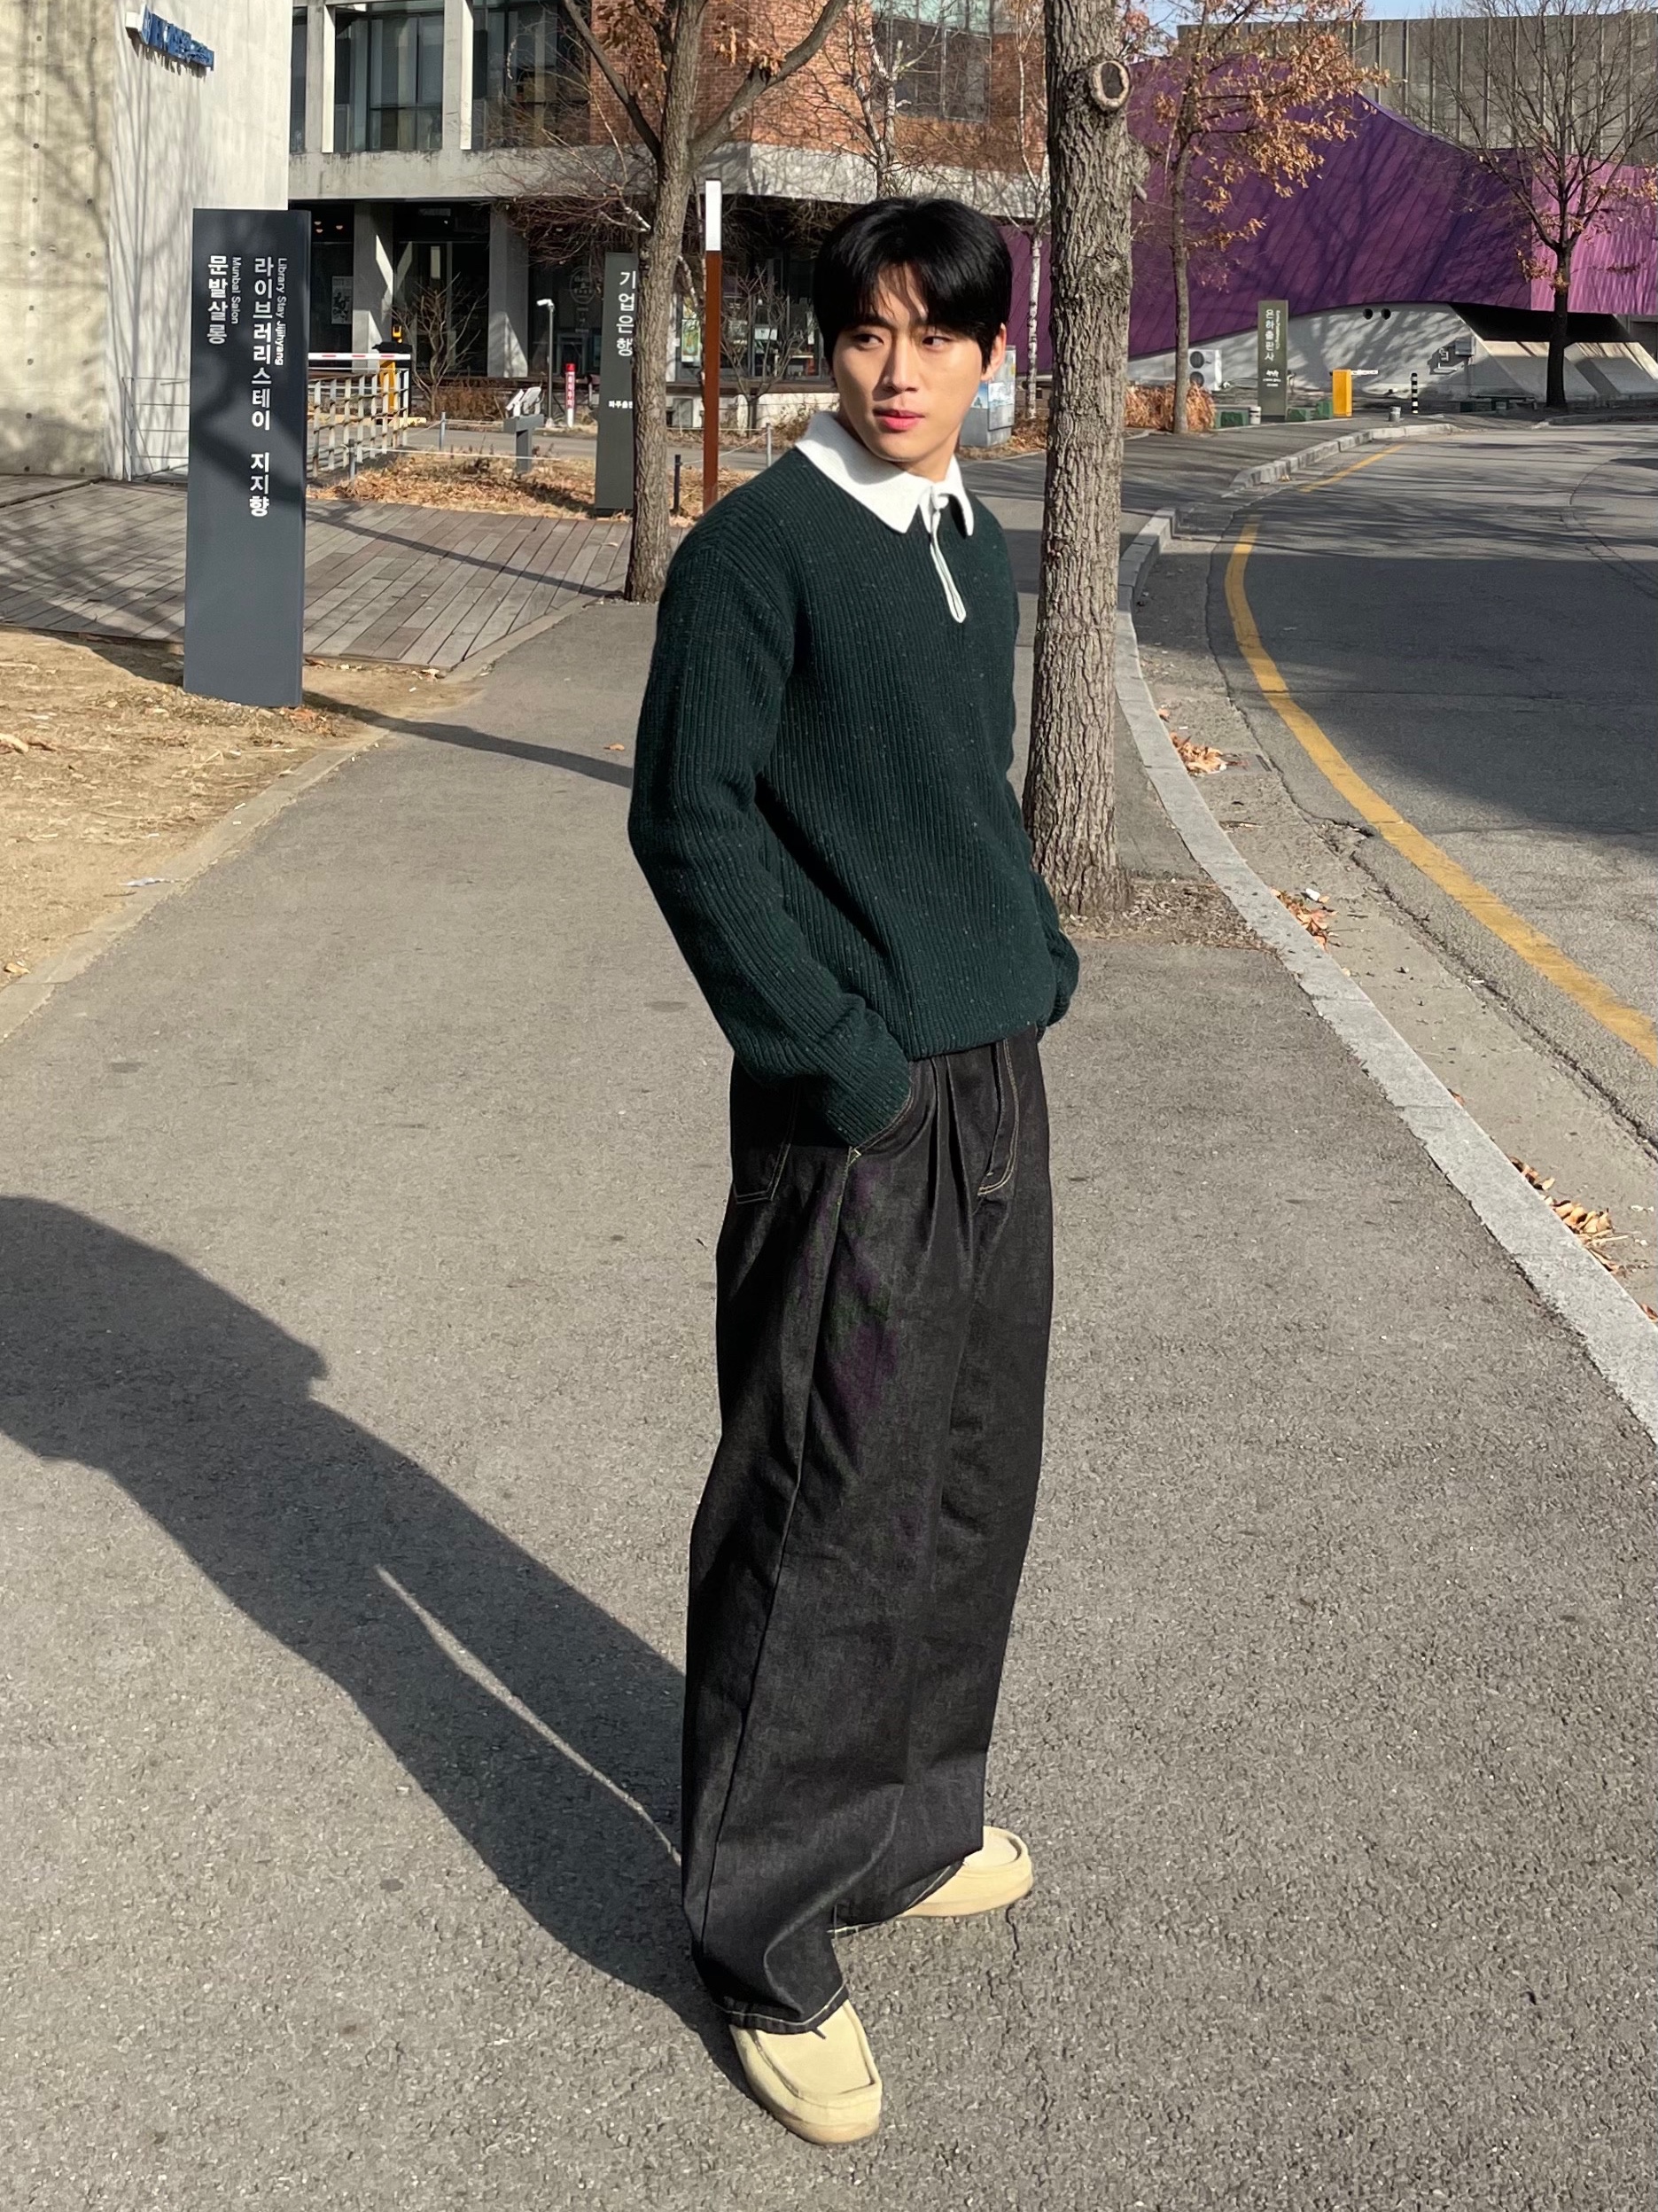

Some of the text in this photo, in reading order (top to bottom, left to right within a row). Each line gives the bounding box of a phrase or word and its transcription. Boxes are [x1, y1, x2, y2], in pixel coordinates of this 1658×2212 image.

[207, 255, 229, 345] 문발살롱
[230, 256, 242, 324] Munbal Salon
[274, 258, 288, 366] Library Stay Jijihyang
[616, 270, 636, 356] 기업은행
[1265, 309, 1274, 362] 은하출판사
[249, 256, 274, 517] 라이브러리스테이 지지향
